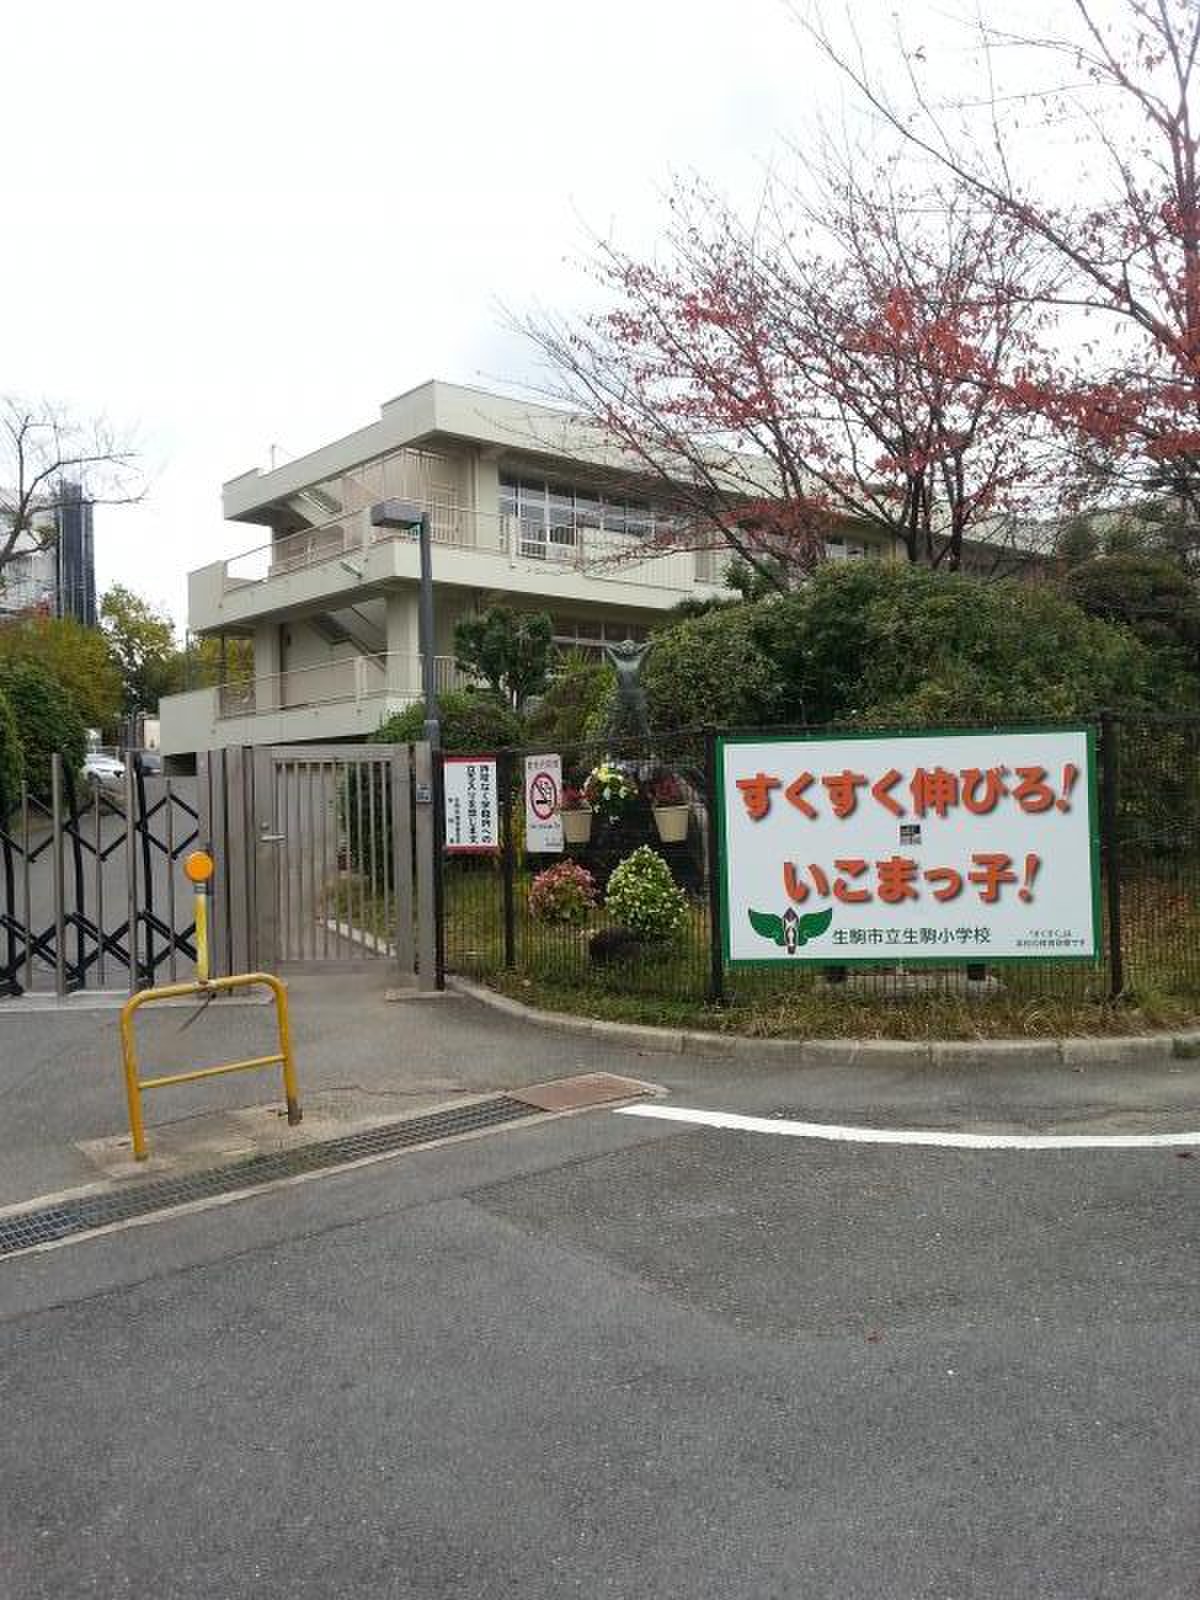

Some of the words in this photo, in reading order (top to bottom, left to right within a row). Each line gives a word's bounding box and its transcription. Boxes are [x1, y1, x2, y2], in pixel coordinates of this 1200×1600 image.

[736, 763, 1079, 821] すくすく伸びろ!
[783, 853, 1042, 905] いこまっ子!
[832, 927, 992, 946] 生駒市立生駒小学校
